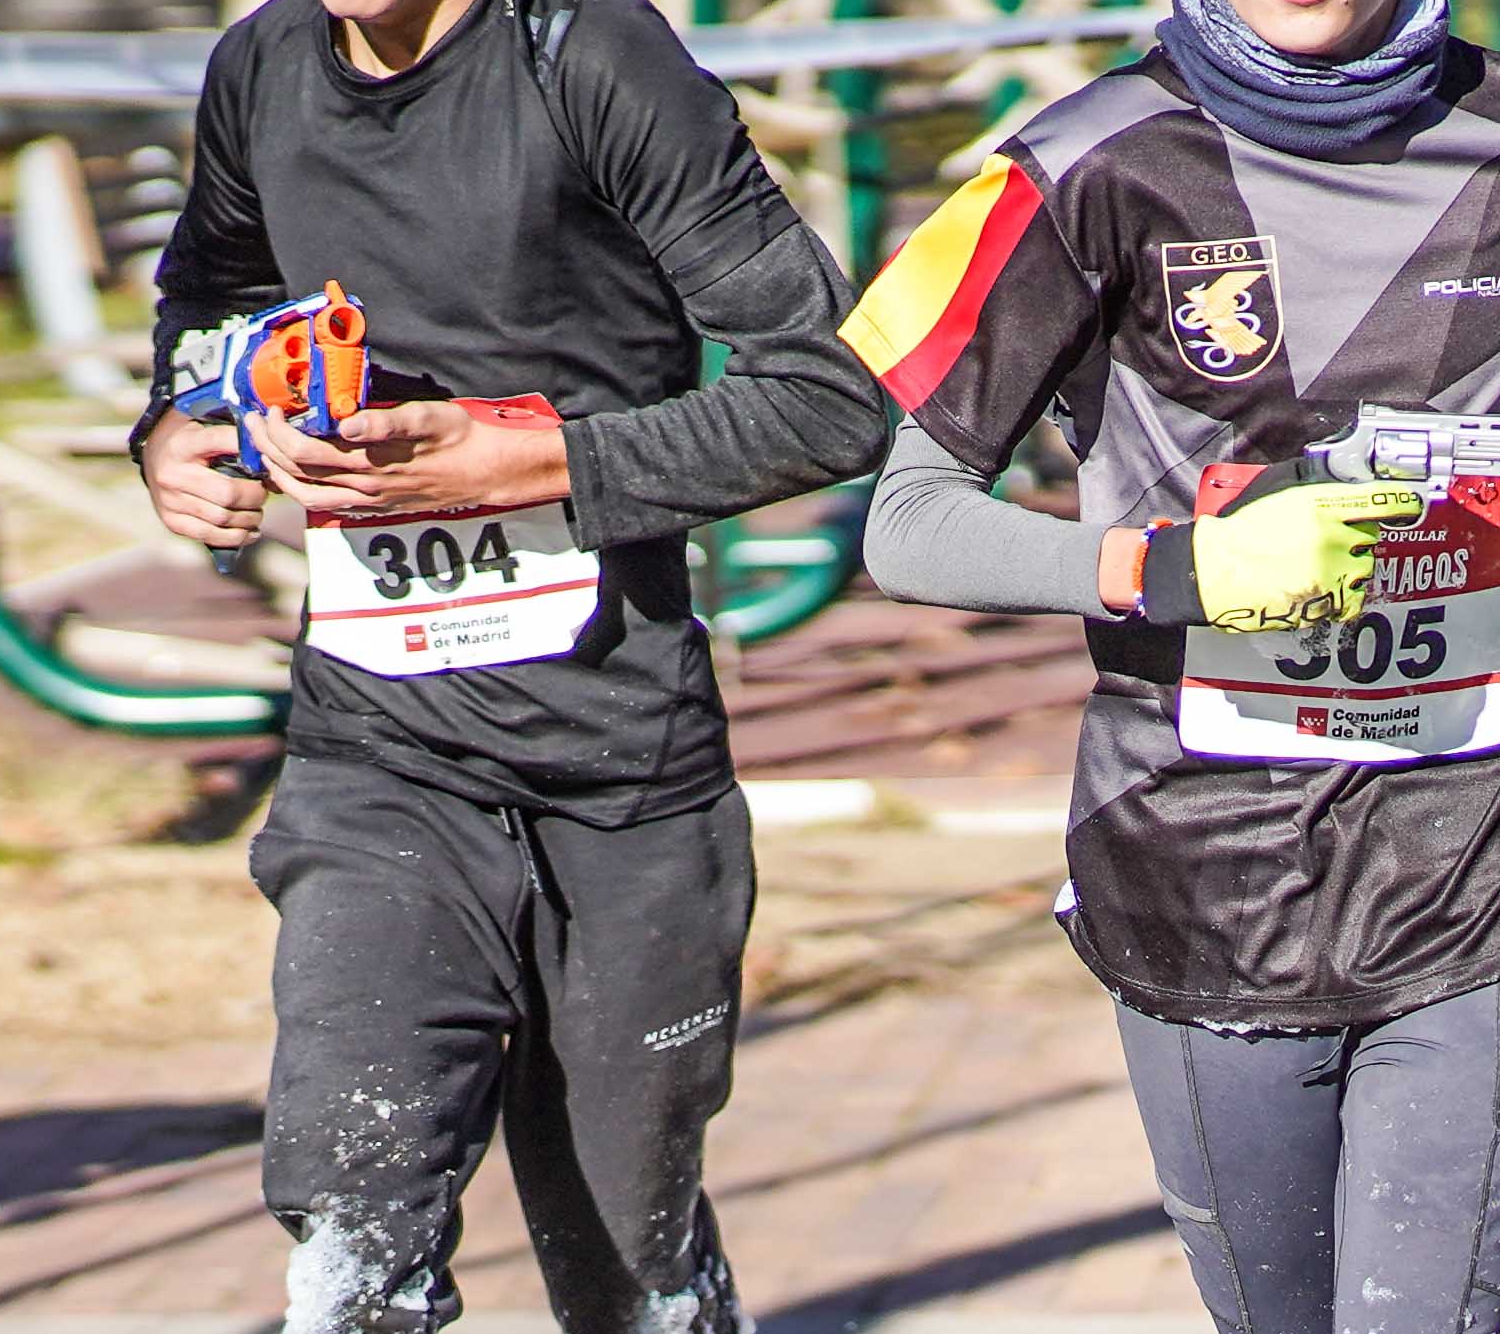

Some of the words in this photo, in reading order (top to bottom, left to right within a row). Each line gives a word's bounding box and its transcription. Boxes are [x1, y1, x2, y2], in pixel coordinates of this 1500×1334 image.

[1190, 243, 1252, 265] G.E.O.
[1371, 492, 1418, 505] COLD
[1379, 530, 1448, 542] POPULAR
[368, 521, 520, 600] 304
[1375, 548, 1469, 595] MAGOS
[430, 614, 509, 632] Comunidad
[434, 637, 451, 649] de
[457, 630, 511, 648] Madrid
[1333, 706, 1420, 722] Comunidad
[1332, 725, 1354, 738] de
[1361, 722, 1419, 740] Madrid
